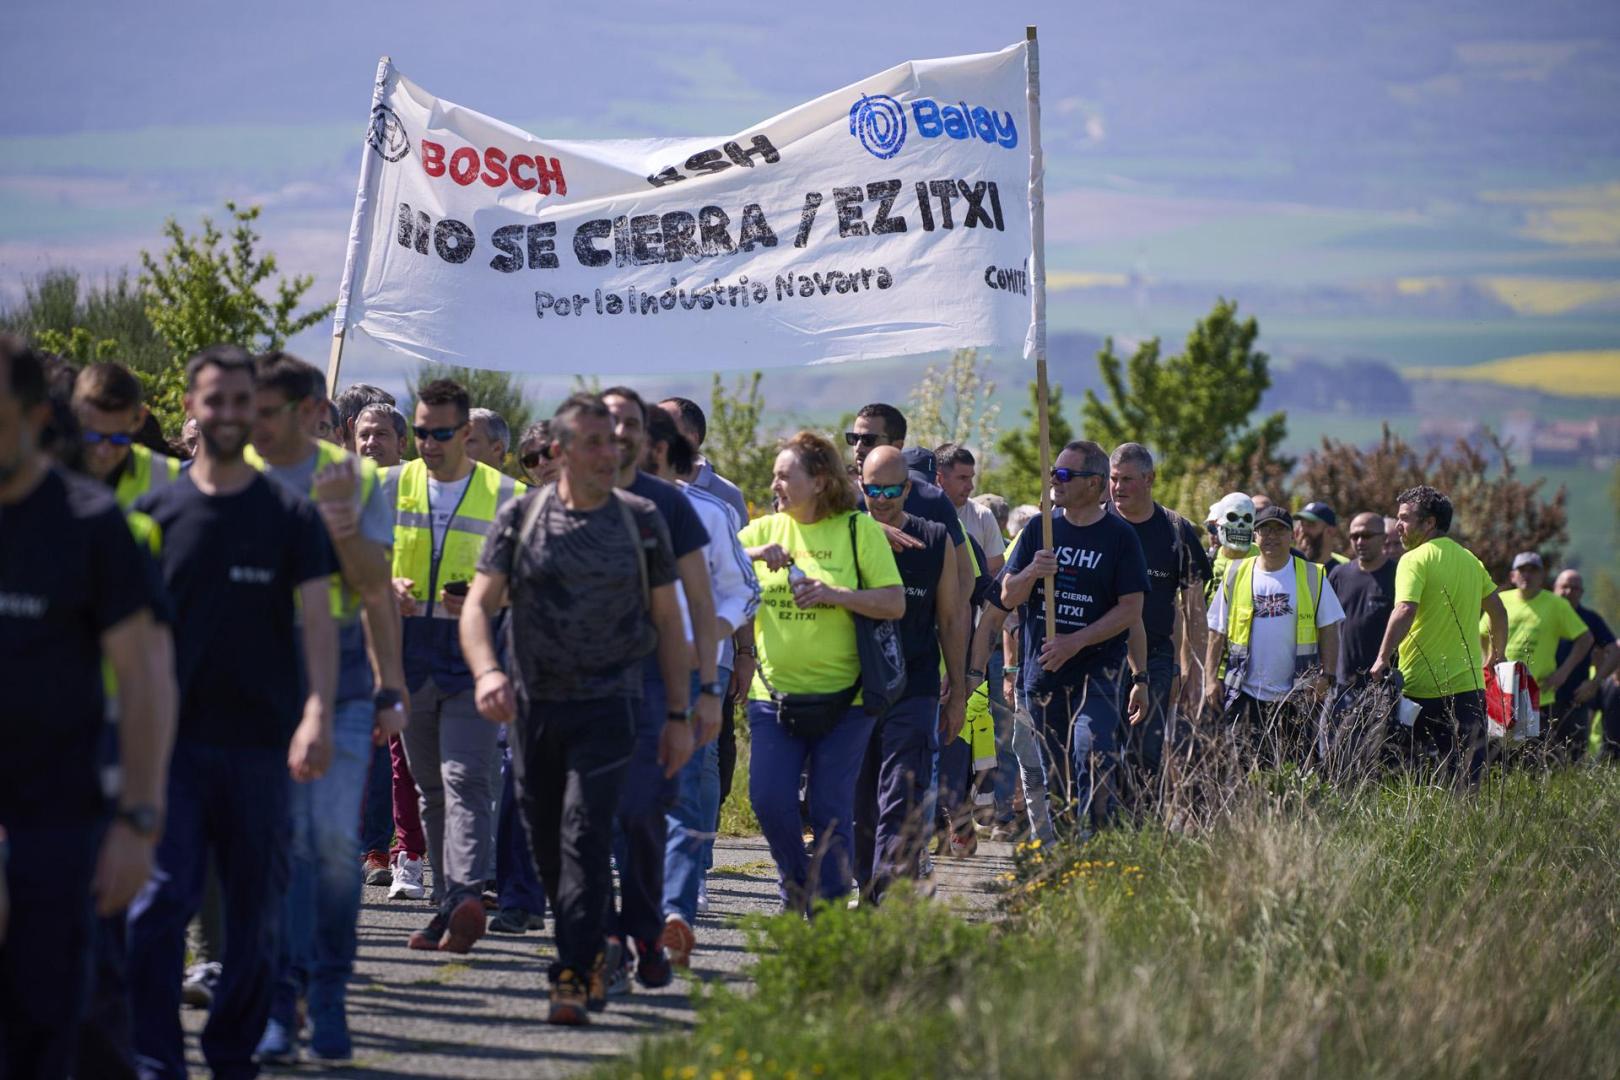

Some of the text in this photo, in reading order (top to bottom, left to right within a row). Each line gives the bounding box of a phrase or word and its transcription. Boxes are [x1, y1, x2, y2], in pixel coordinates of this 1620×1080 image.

[911, 99, 1018, 149] Balay
[421, 139, 567, 197] BOSCH
[489, 221, 560, 273] SE
[572, 203, 778, 268] CIERRA
[794, 192, 823, 248] /
[833, 179, 907, 239] EZ
[915, 179, 1004, 232] ITXI
[534, 289, 591, 319] Por
[775, 266, 893, 302] Navarra
[1052, 545, 1102, 569] /S/H/
[1057, 604, 1084, 617] ITXI
[1061, 591, 1094, 603] CIERRA
[778, 611, 817, 621] EZ ITXI
